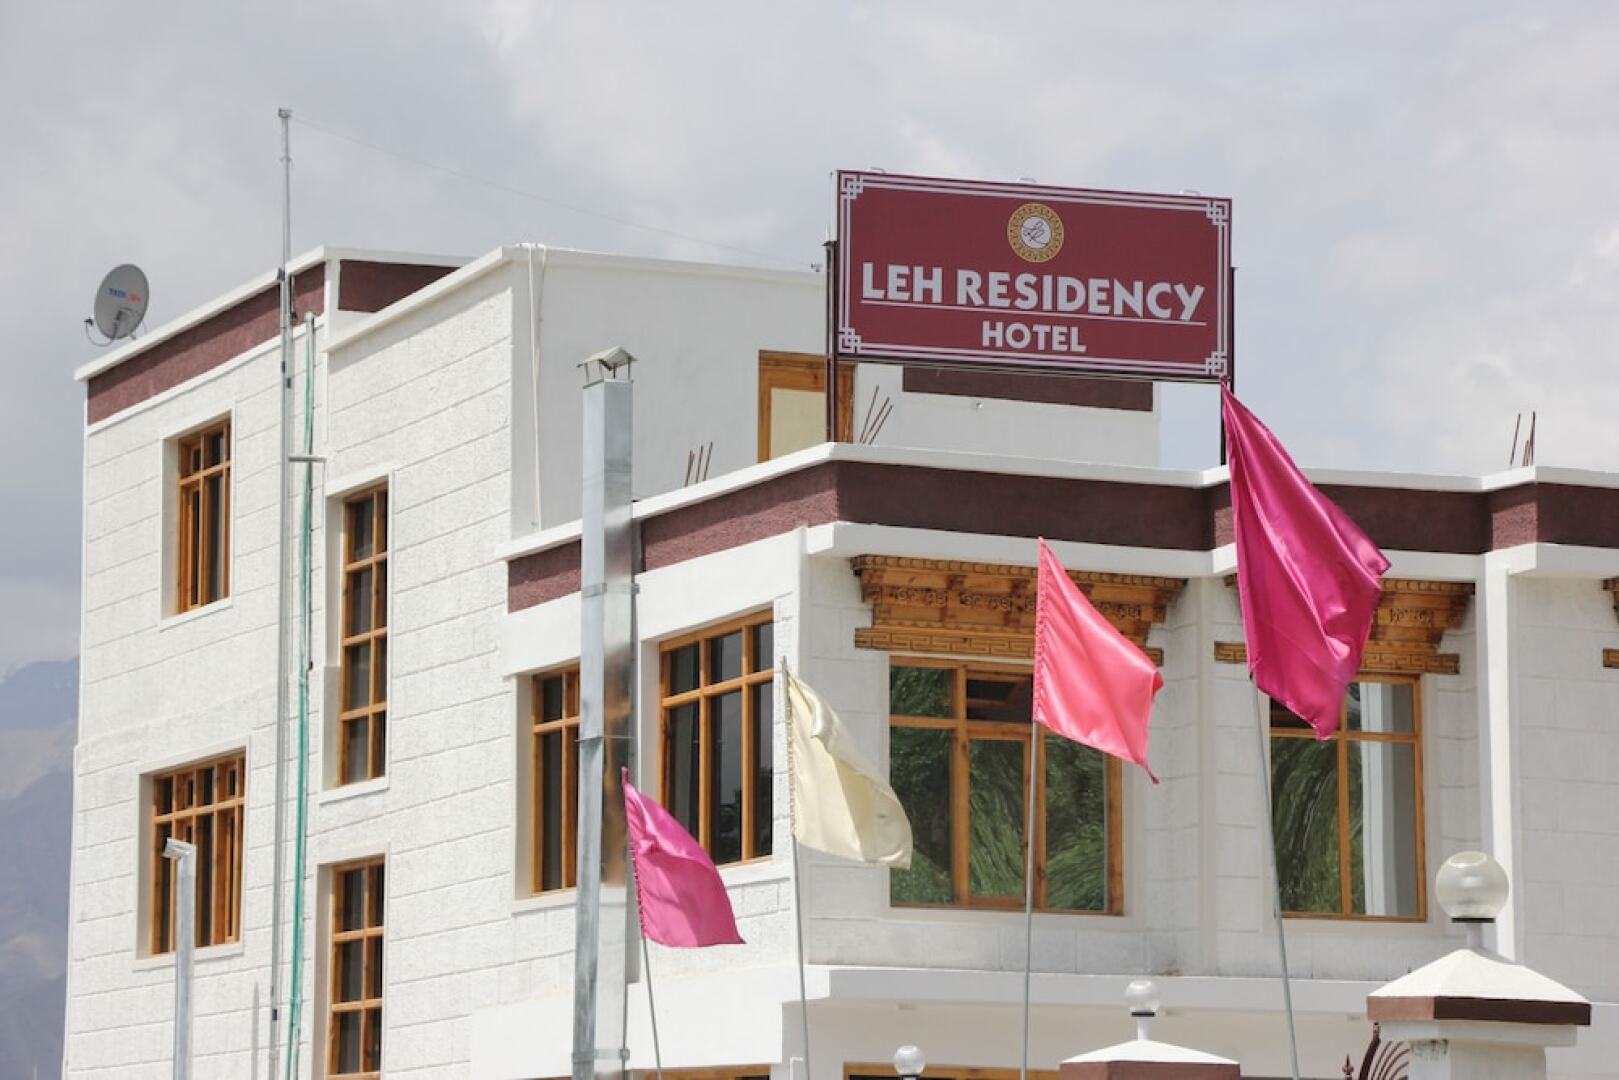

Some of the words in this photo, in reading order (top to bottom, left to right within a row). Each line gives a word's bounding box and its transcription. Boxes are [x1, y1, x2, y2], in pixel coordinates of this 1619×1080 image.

[862, 262, 943, 304] LEH
[956, 269, 1205, 321] RESIDENCY
[982, 320, 1087, 352] HOTEL
